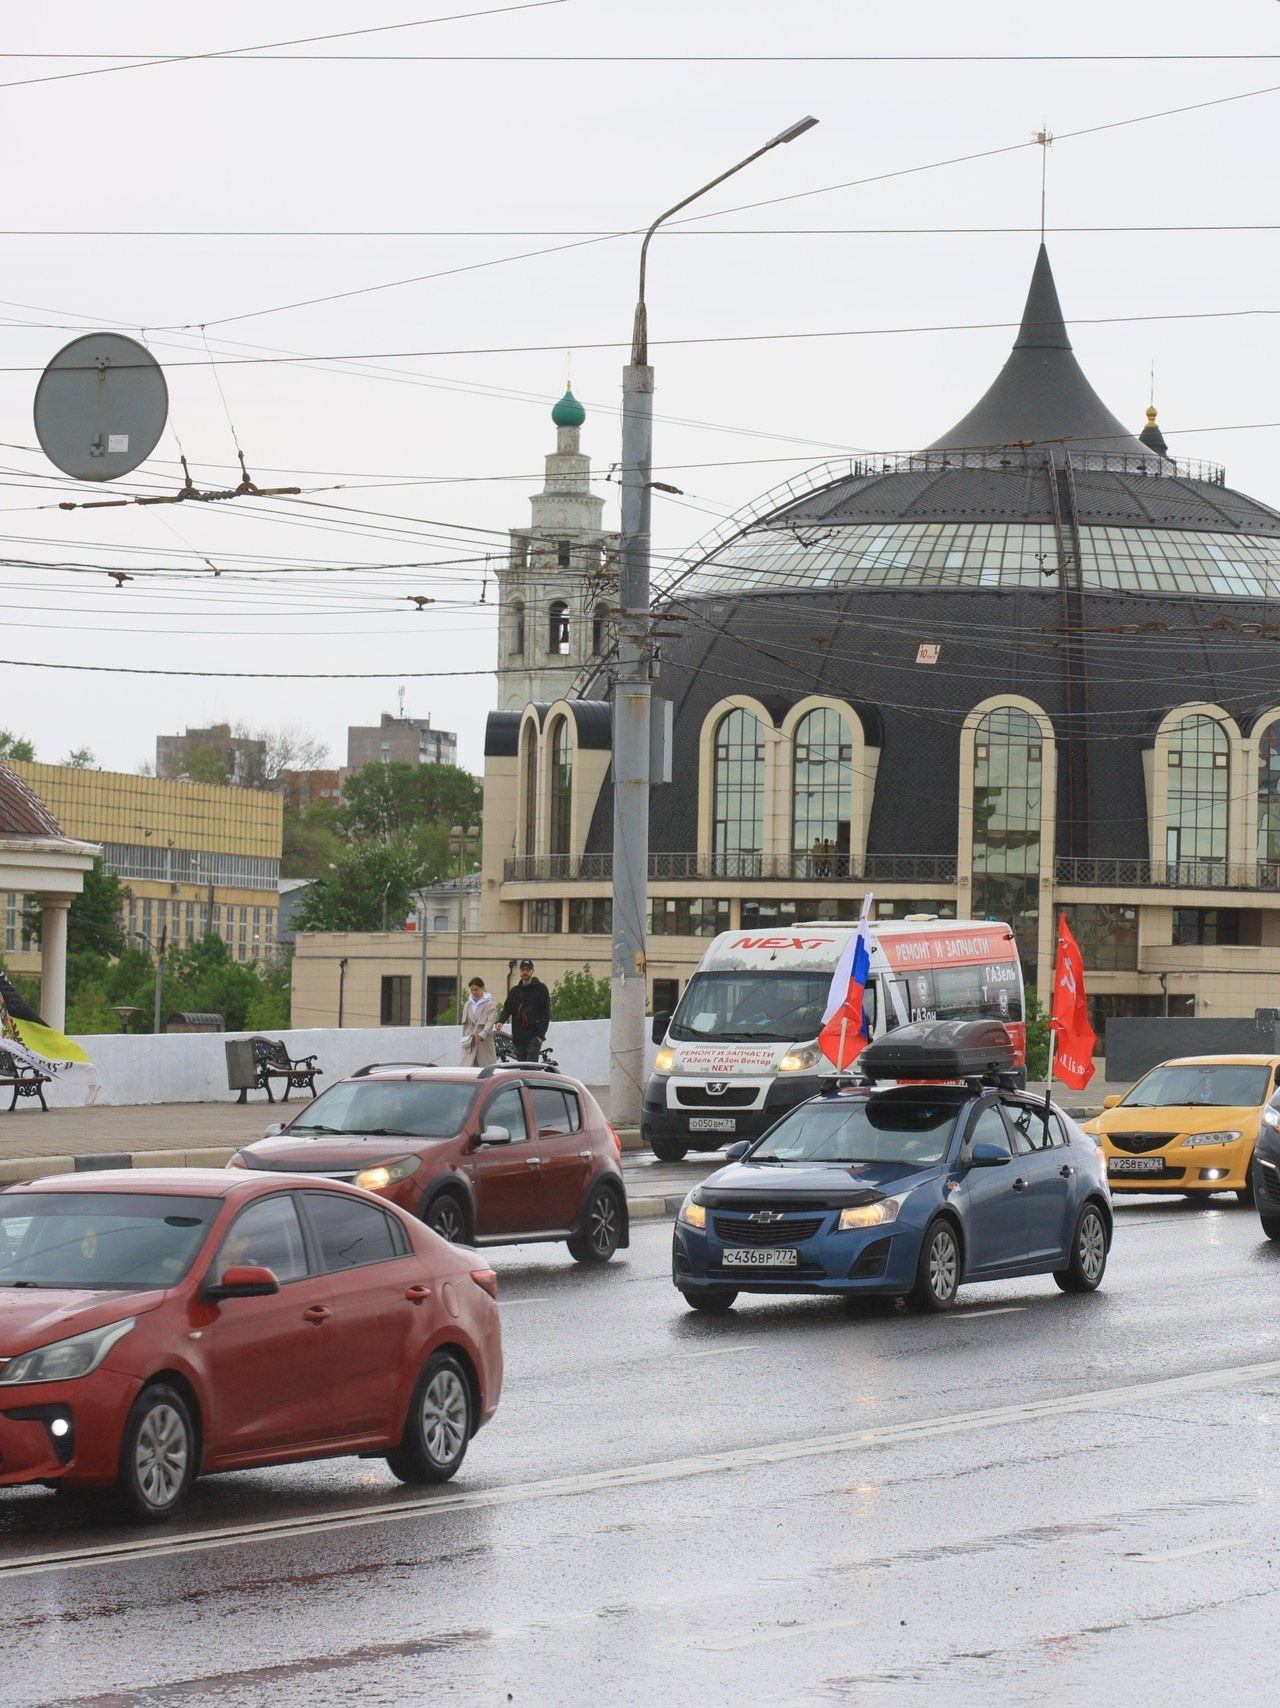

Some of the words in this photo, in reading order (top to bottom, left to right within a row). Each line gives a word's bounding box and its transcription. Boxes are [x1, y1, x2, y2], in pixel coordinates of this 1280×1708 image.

[729, 937, 836, 949] NEXT
[896, 941, 931, 961] РЕМОНТ
[934, 941, 944, 958] И
[945, 937, 990, 957] ЗАПЧАСТИ
[985, 965, 1016, 983] ГАЗель
[911, 1007, 937, 1022] ГАЗон
[727, 1050, 775, 1058] ЗАПЧАСТИ
[741, 1057, 771, 1066] Вектор
[711, 1064, 734, 1072] NEXT
